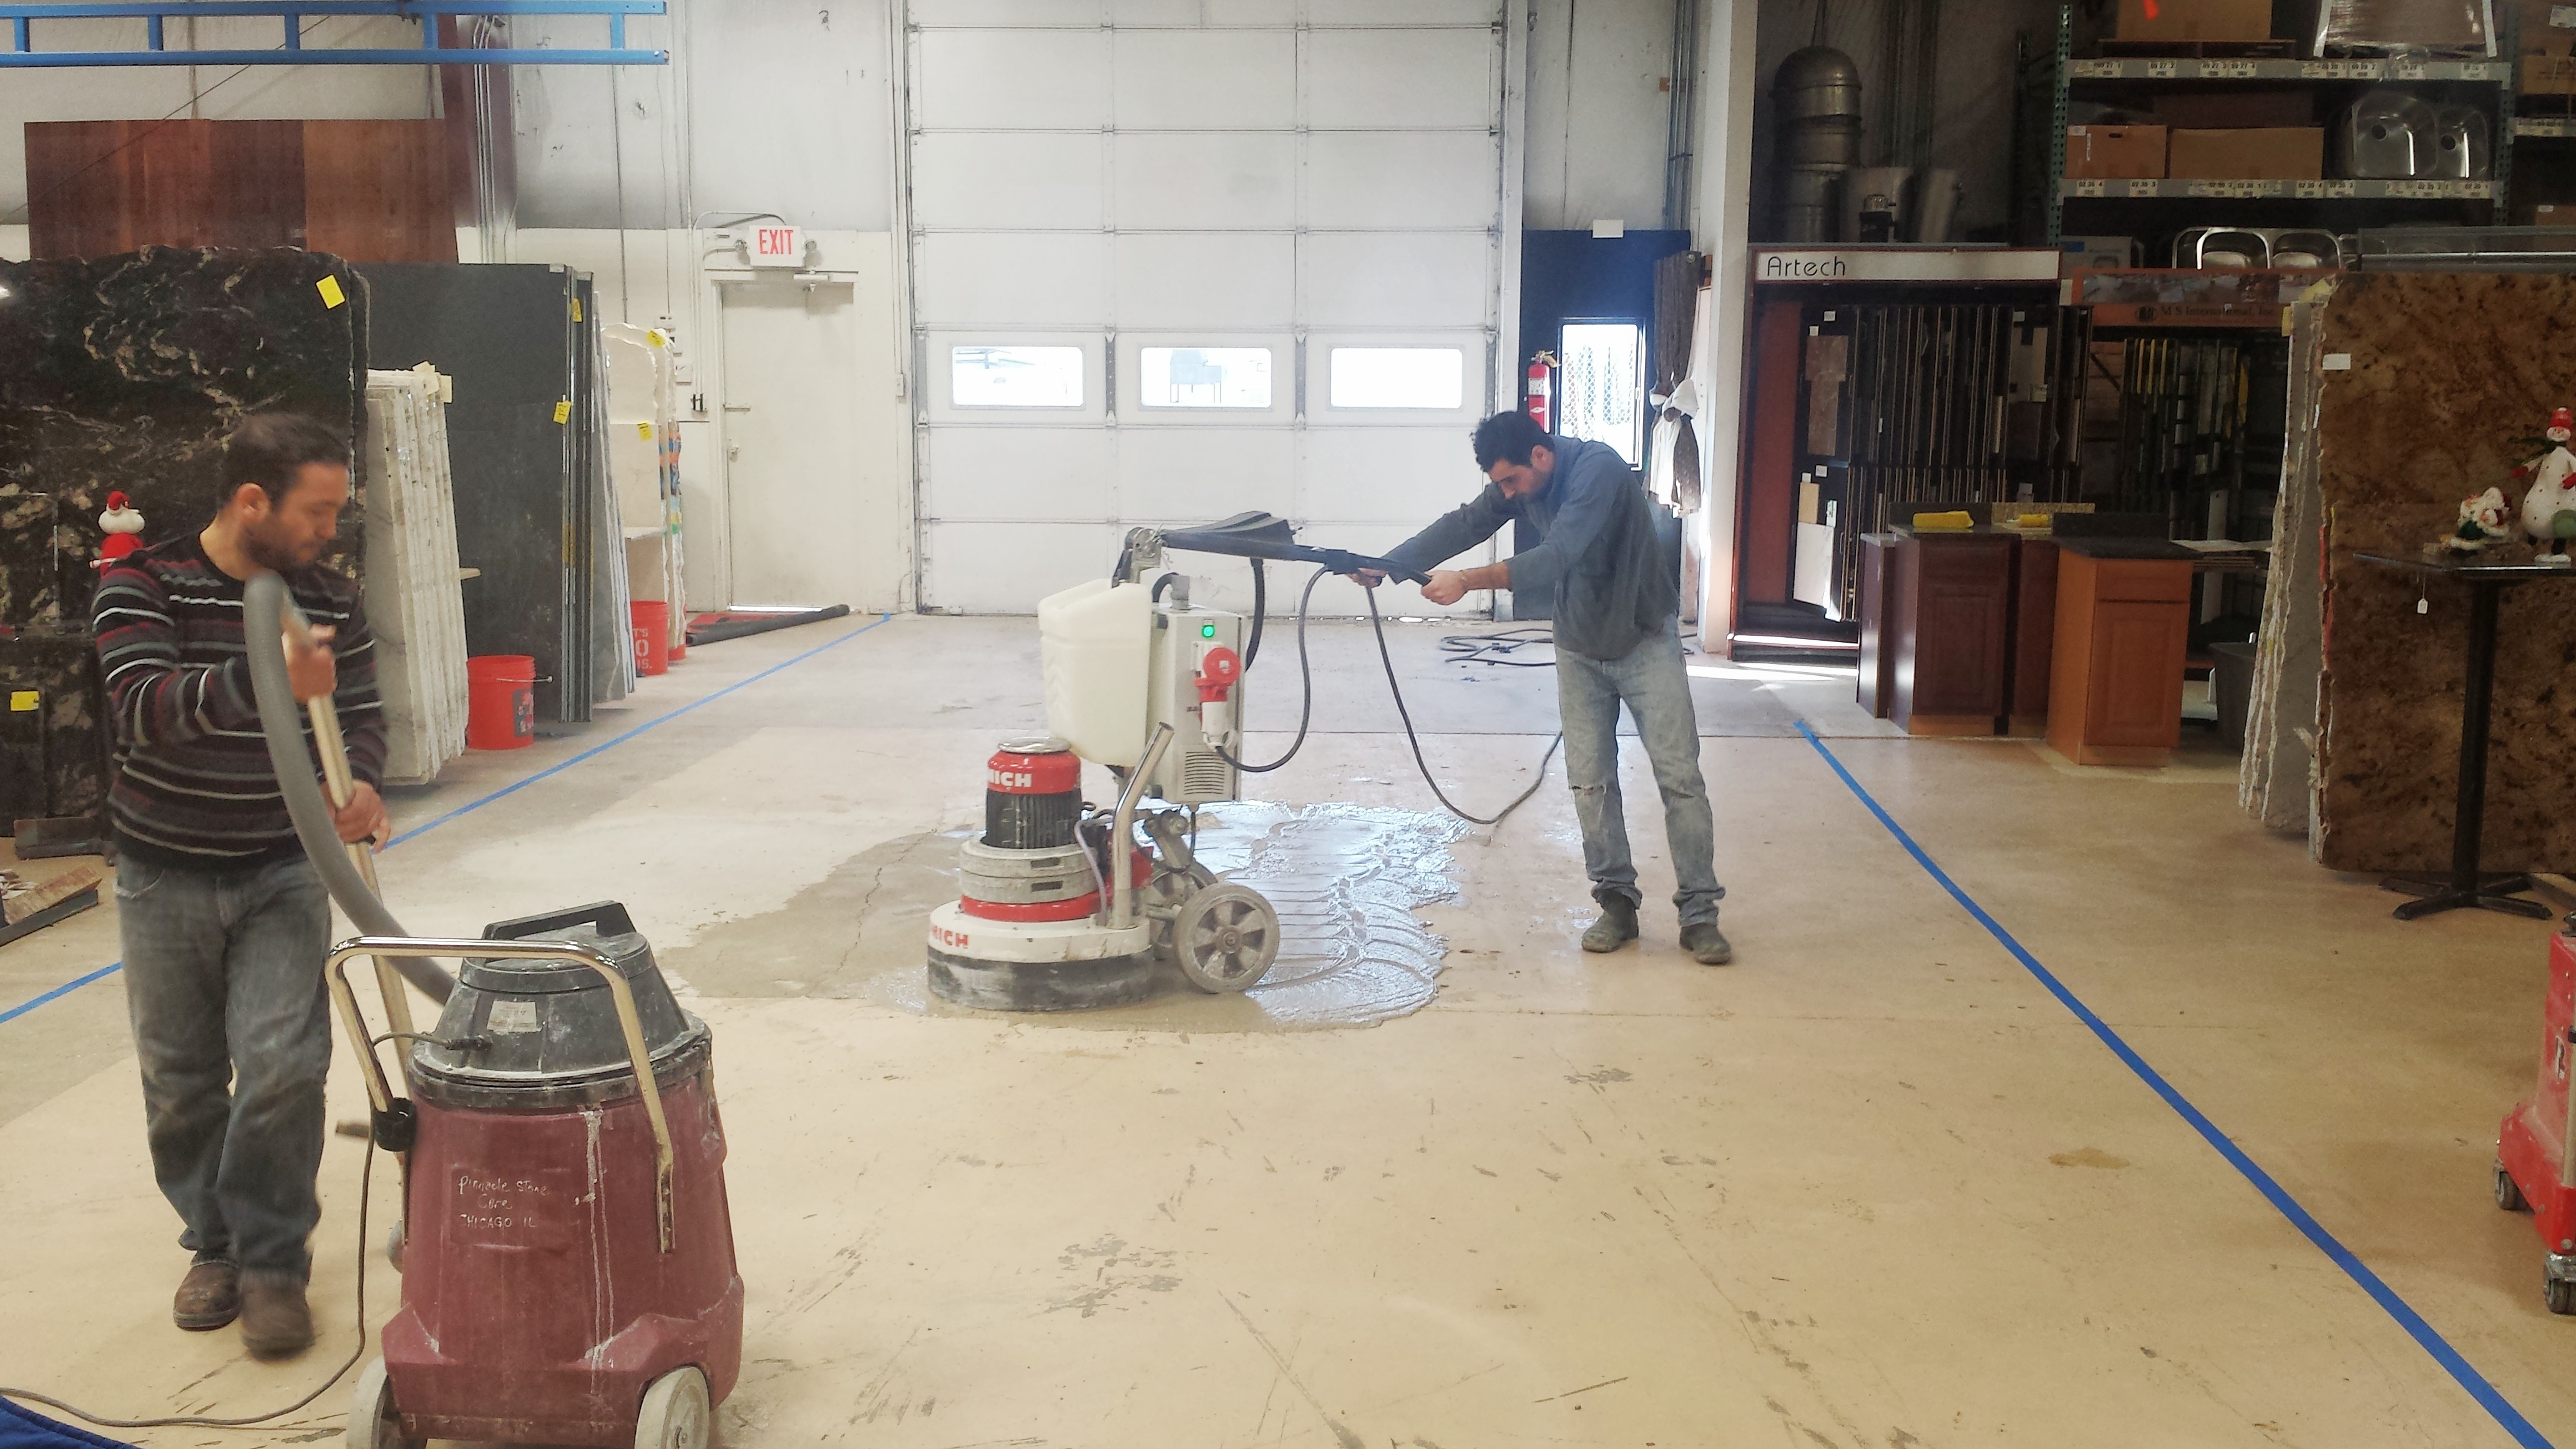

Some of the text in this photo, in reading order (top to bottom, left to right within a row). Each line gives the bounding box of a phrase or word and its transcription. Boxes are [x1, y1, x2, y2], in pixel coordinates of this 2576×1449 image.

[759, 229, 794, 255] EXIT
[1767, 256, 1846, 277] Artech
[2186, 306, 2255, 317] Internaonal,
[633, 628, 648, 637] T'S
[635, 639, 649, 657] O
[637, 659, 652, 669] IS.
[459, 1176, 510, 1194] Pinnacle
[478, 1193, 512, 1209] Care
[459, 1214, 537, 1229] CHICAGO IL
